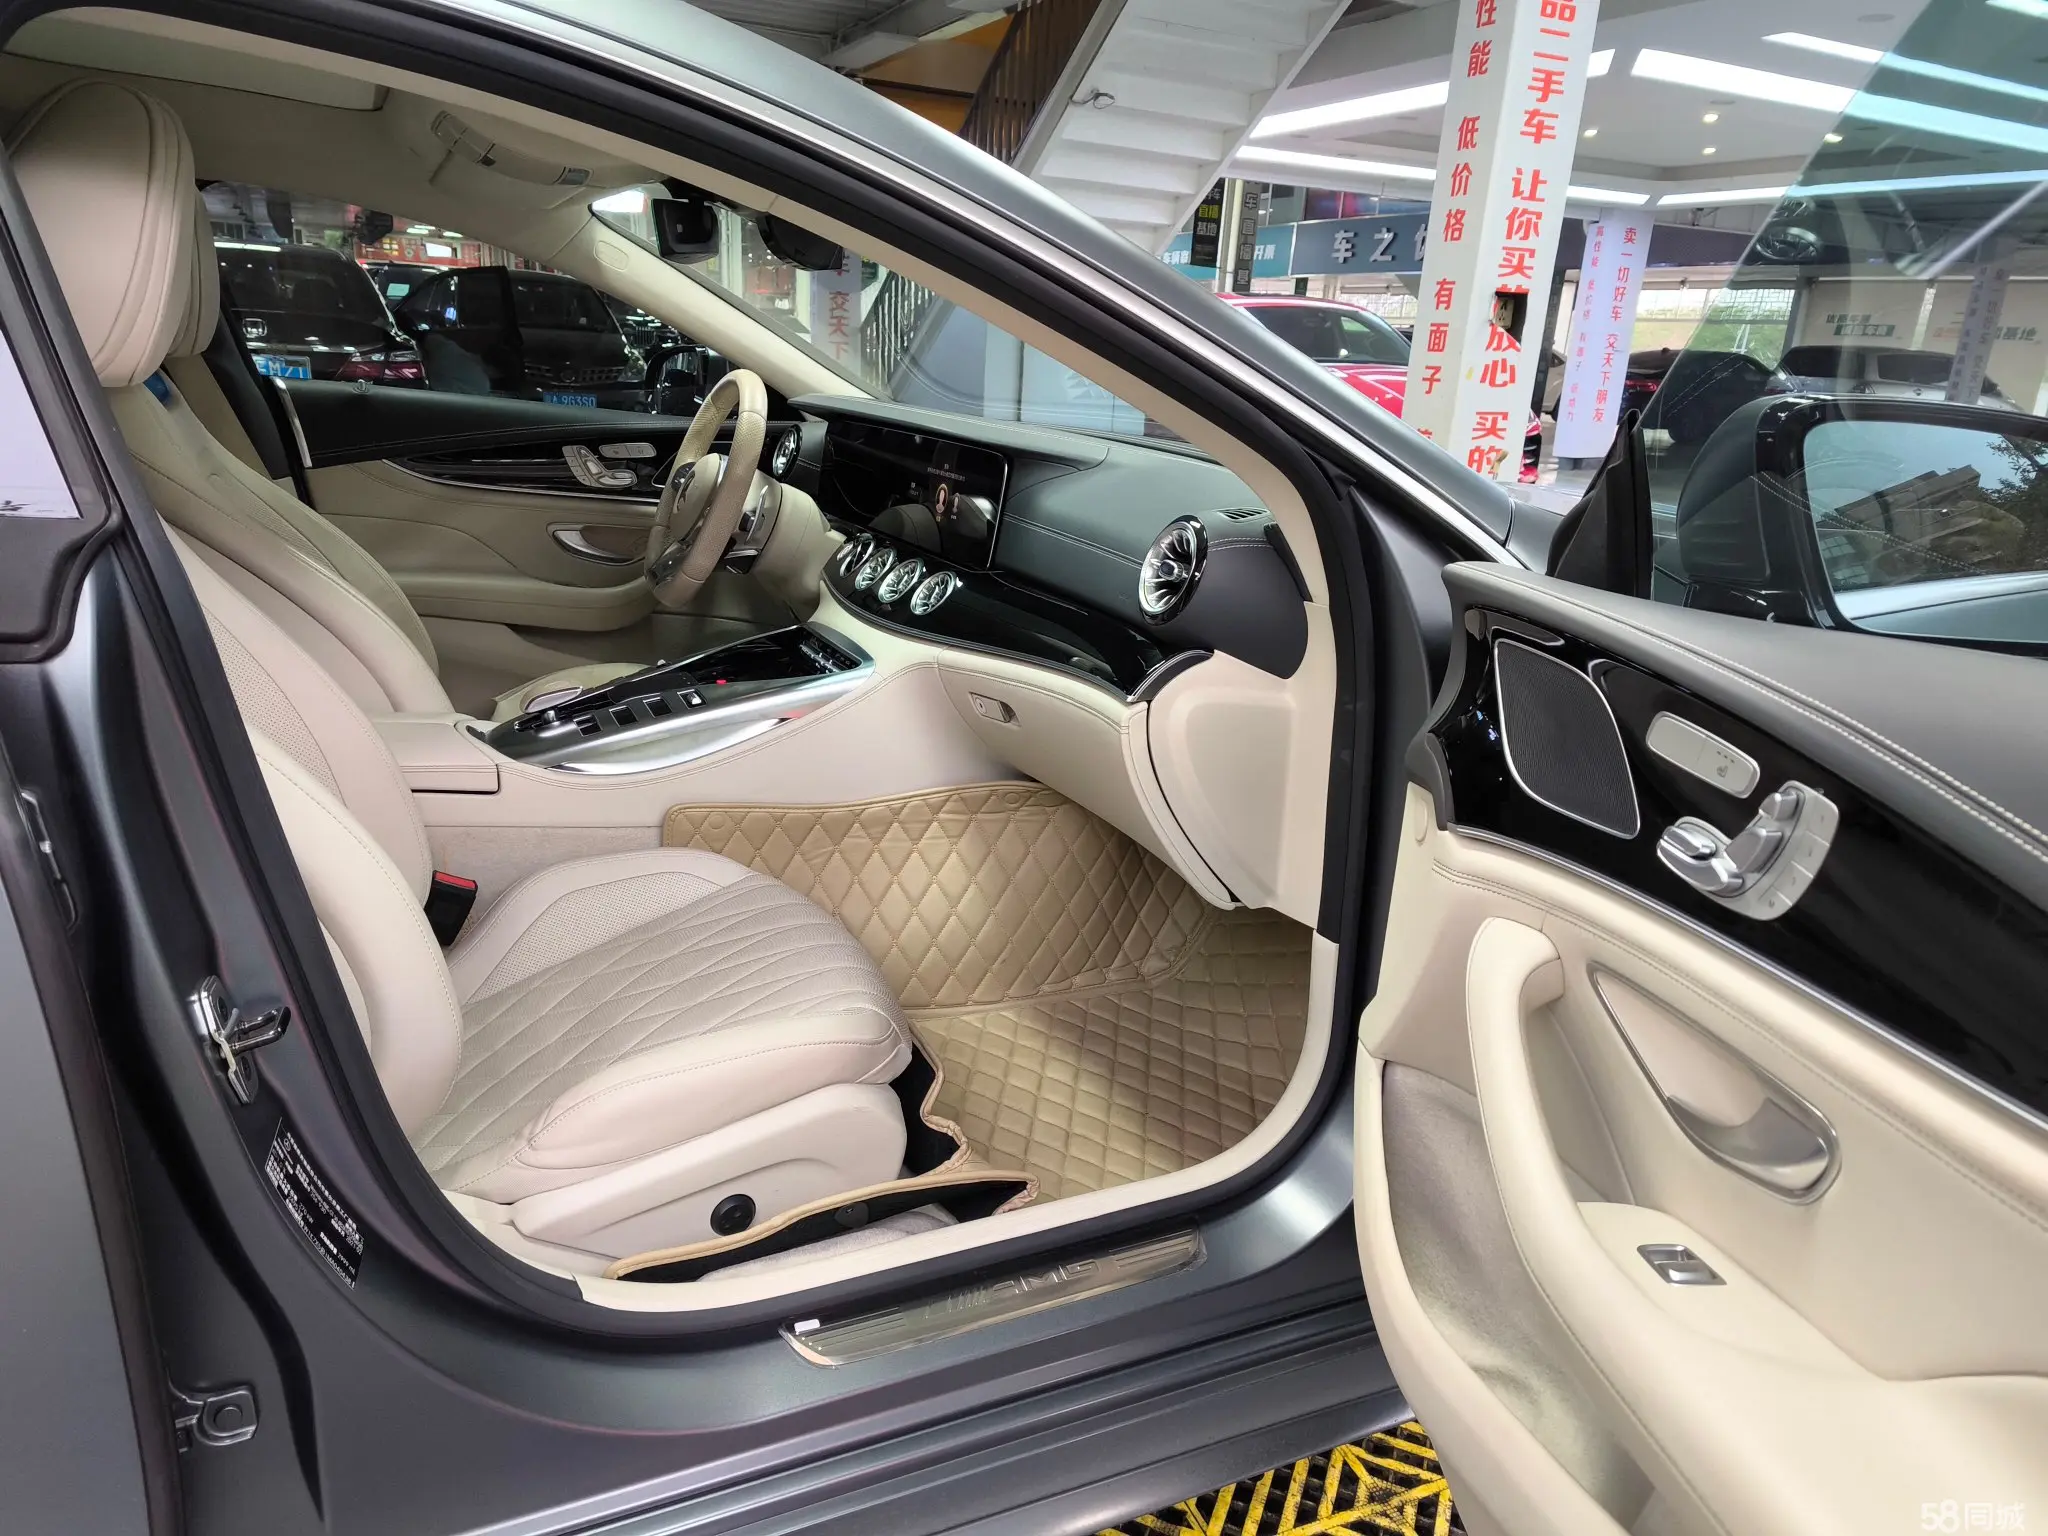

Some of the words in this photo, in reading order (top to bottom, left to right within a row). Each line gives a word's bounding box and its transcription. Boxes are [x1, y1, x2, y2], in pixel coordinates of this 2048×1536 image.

[1467, 0, 1497, 77] 性能
[1520, 0, 1577, 145] 品二手车
[1444, 115, 1479, 243] 低价格
[829, 291, 849, 360] 交天下
[1479, 167, 1548, 389] 让你买放心
[1610, 227, 1637, 321] 卖一切好车
[1422, 277, 1456, 395] 有面子
[1592, 333, 1619, 423] 交天下朋友
